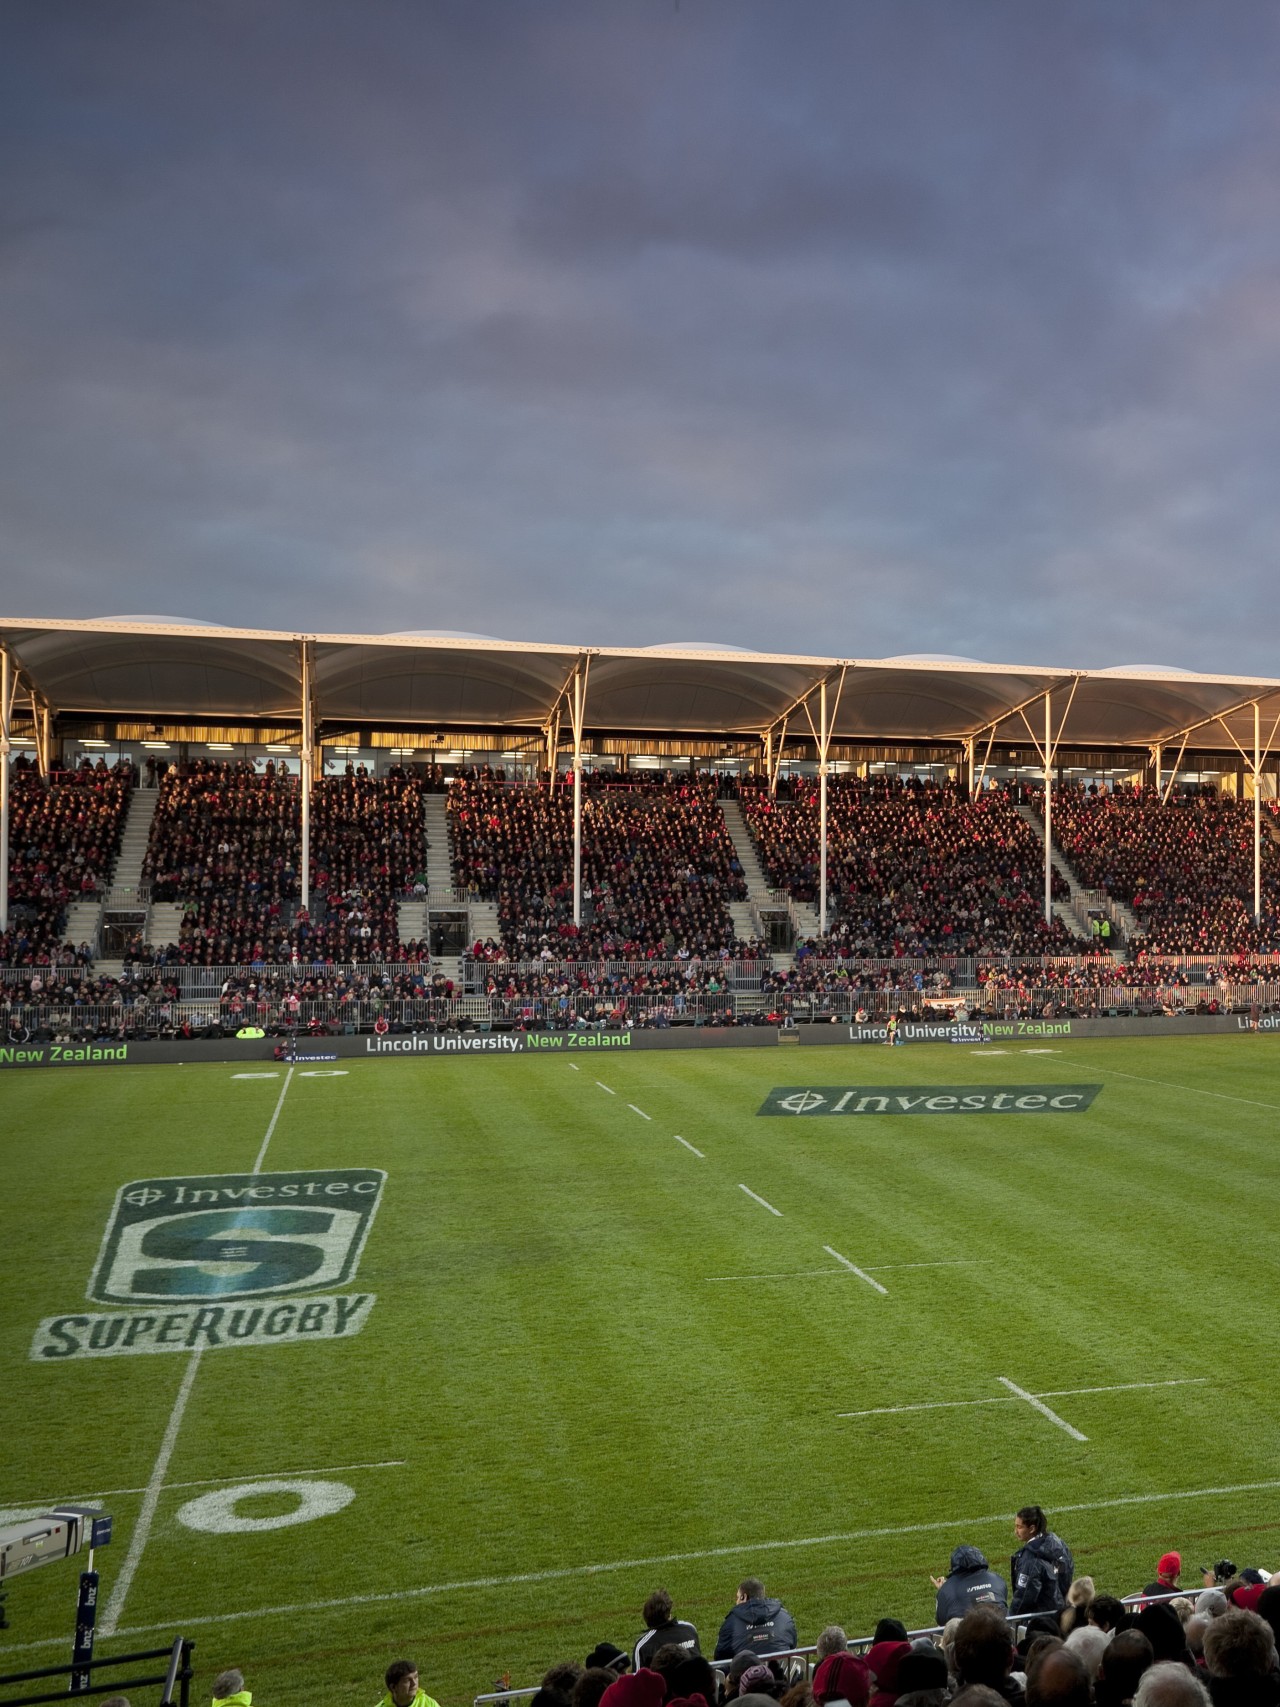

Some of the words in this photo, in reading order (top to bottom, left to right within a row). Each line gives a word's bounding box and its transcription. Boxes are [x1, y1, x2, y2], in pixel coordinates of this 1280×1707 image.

[850, 1026, 901, 1040] Lincon
[984, 1023, 1014, 1036] New
[1018, 1021, 1071, 1035] Zealand
[366, 1036, 428, 1052] Lincoln
[434, 1034, 523, 1052] University,
[527, 1034, 563, 1048] New
[568, 1032, 631, 1047] Zealand
[0, 1048, 44, 1063] New
[50, 1044, 128, 1062] Zealand
[830, 1091, 1084, 1112] Investec
[173, 1180, 377, 1204] Investec
[84, 1586, 96, 1606] bnz
[80, 1630, 92, 1649] bnz
[80, 1674, 88, 1689] nz
